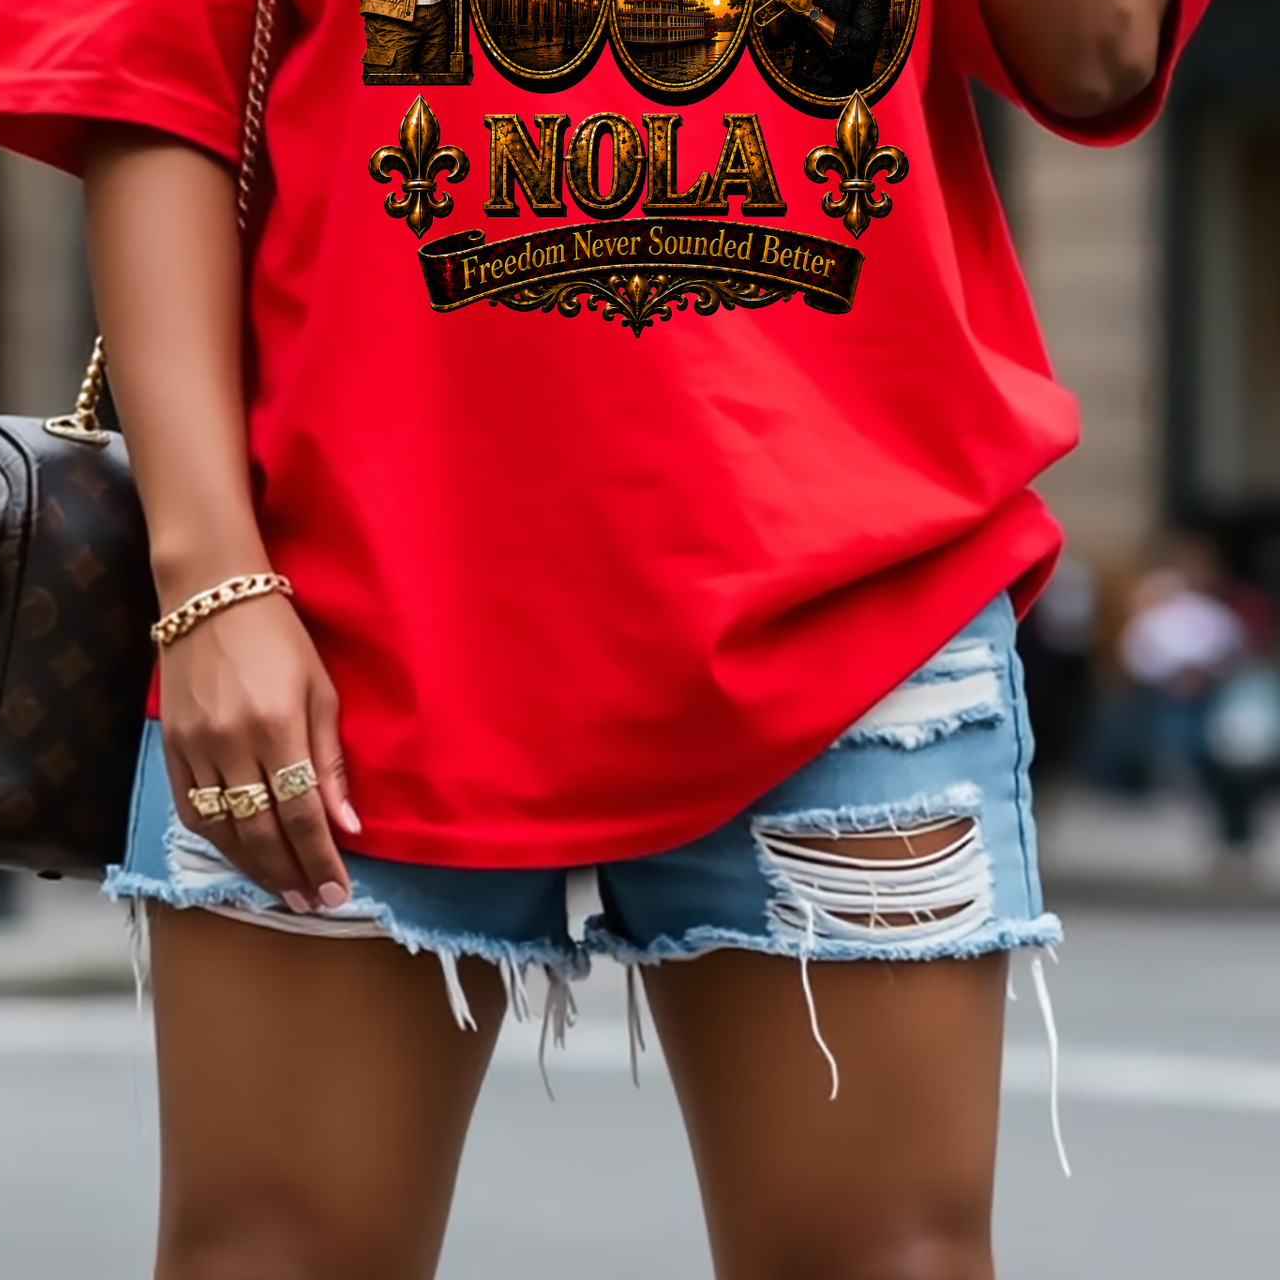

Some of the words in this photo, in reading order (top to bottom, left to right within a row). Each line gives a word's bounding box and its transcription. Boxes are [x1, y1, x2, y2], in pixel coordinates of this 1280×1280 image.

[483, 112, 787, 220] NOLA
[461, 243, 566, 290] Freedom
[572, 229, 641, 261] Never
[648, 225, 751, 261] Sounded
[761, 234, 836, 278] Better
